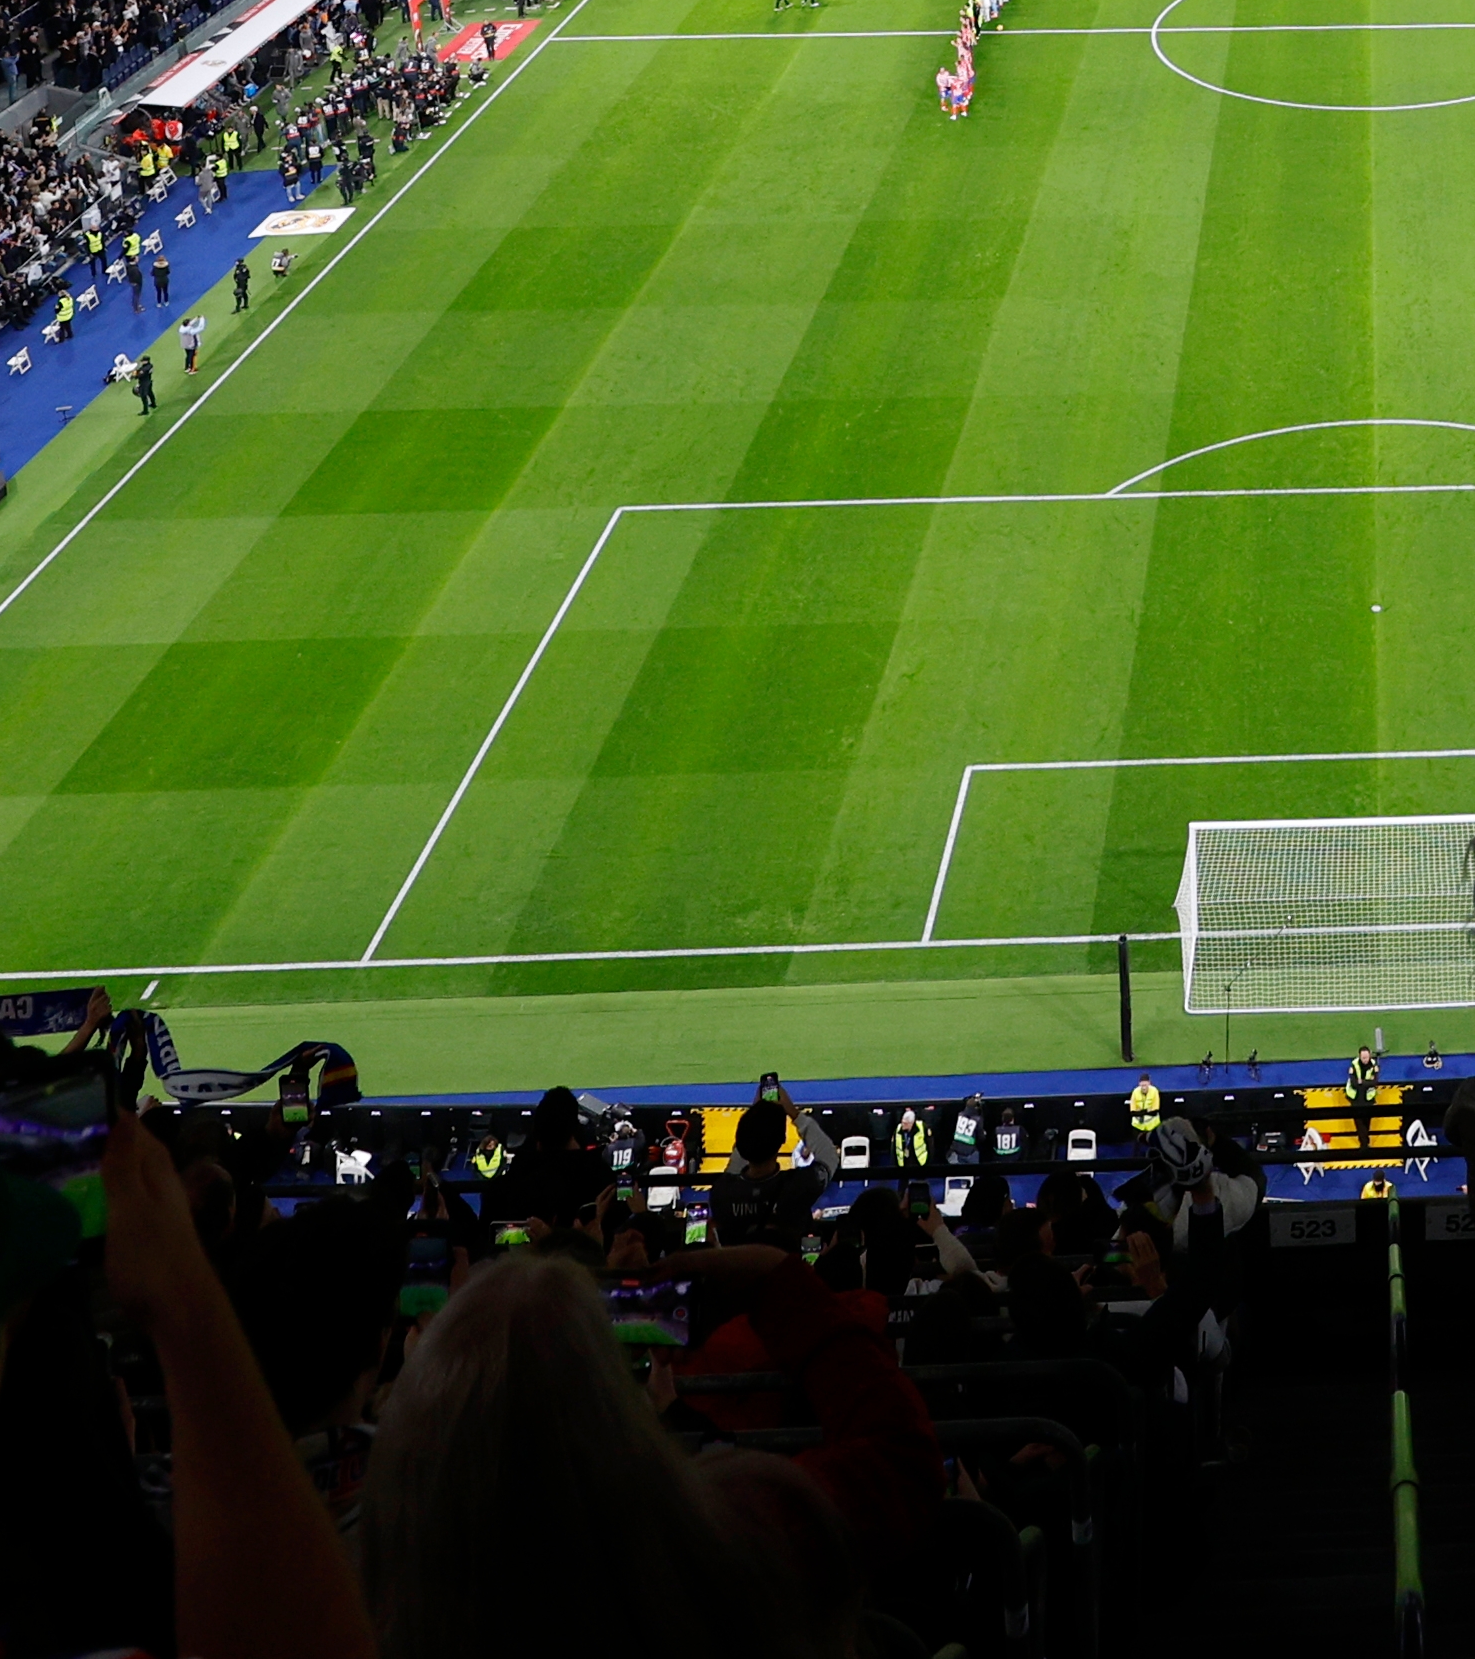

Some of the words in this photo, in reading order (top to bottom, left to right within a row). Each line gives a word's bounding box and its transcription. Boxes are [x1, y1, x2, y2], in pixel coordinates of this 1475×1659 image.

[957, 1115, 977, 1135] 193
[996, 1133, 1017, 1149] 181
[611, 1148, 633, 1165] 119
[732, 1202, 758, 1217] VINI
[1290, 1219, 1336, 1239] 523
